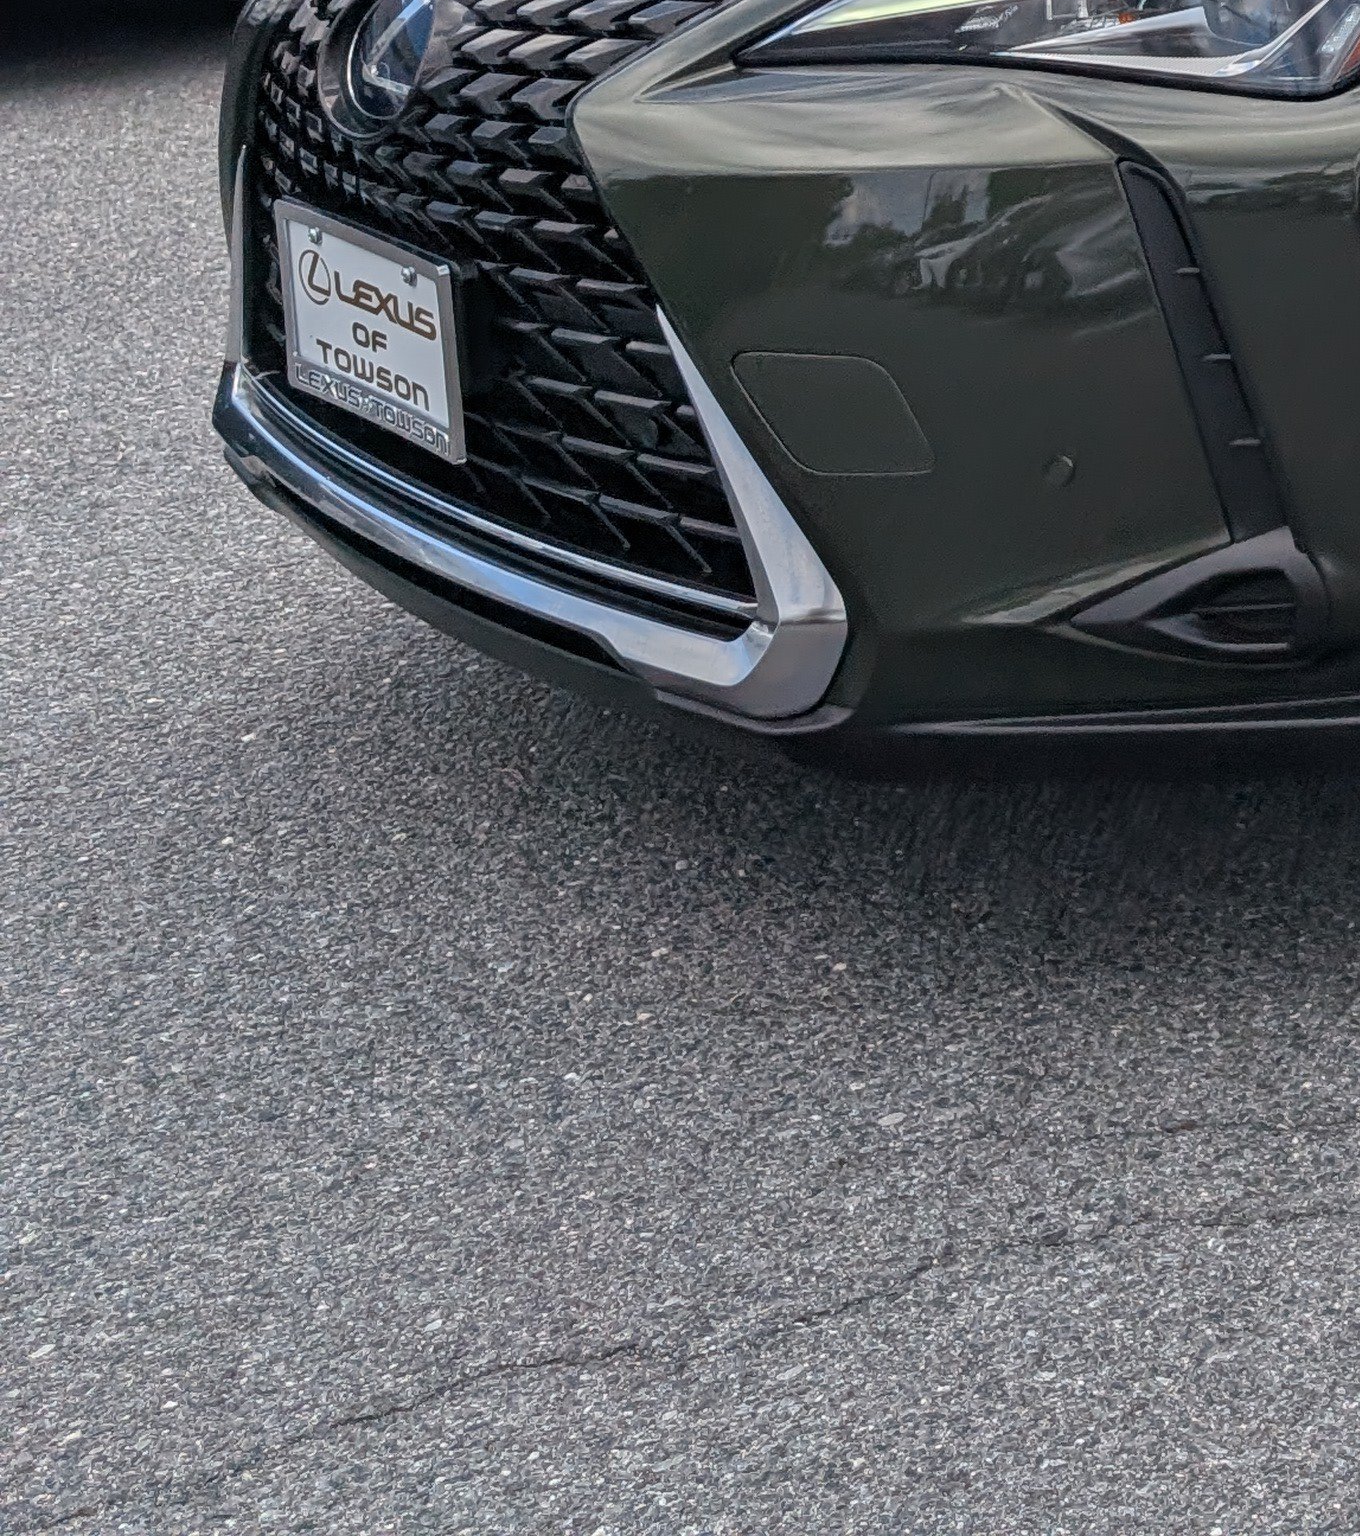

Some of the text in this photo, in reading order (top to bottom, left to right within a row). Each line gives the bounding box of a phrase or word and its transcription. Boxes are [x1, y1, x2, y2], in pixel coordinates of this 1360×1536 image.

[333, 270, 437, 341] LEXUS
[352, 321, 388, 353] OF
[294, 363, 450, 456] LEXUS TOWSON
[315, 338, 430, 412] TOWSON
